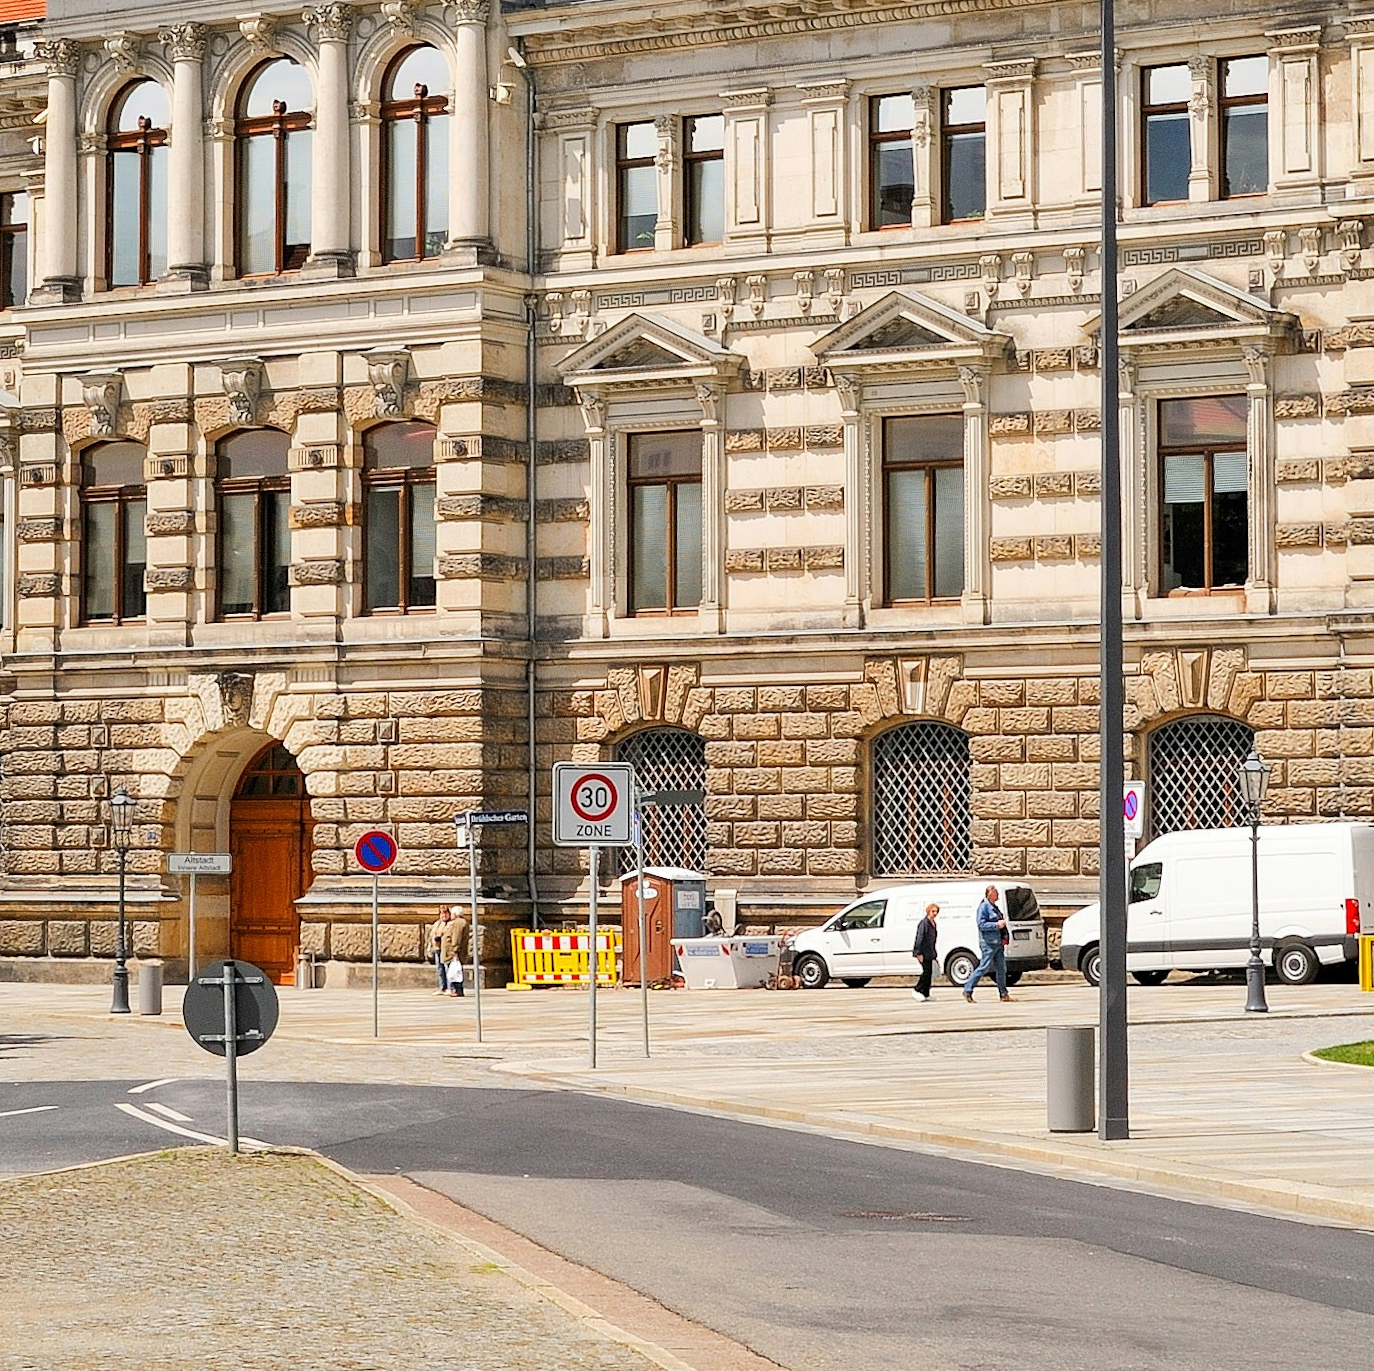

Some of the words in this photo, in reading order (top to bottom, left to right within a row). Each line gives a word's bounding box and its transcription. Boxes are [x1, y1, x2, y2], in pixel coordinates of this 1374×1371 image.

[580, 787, 607, 808] 30
[505, 813, 527, 822] Garten
[576, 825, 612, 837] ZONE
[184, 856, 214, 864] Altstadt
